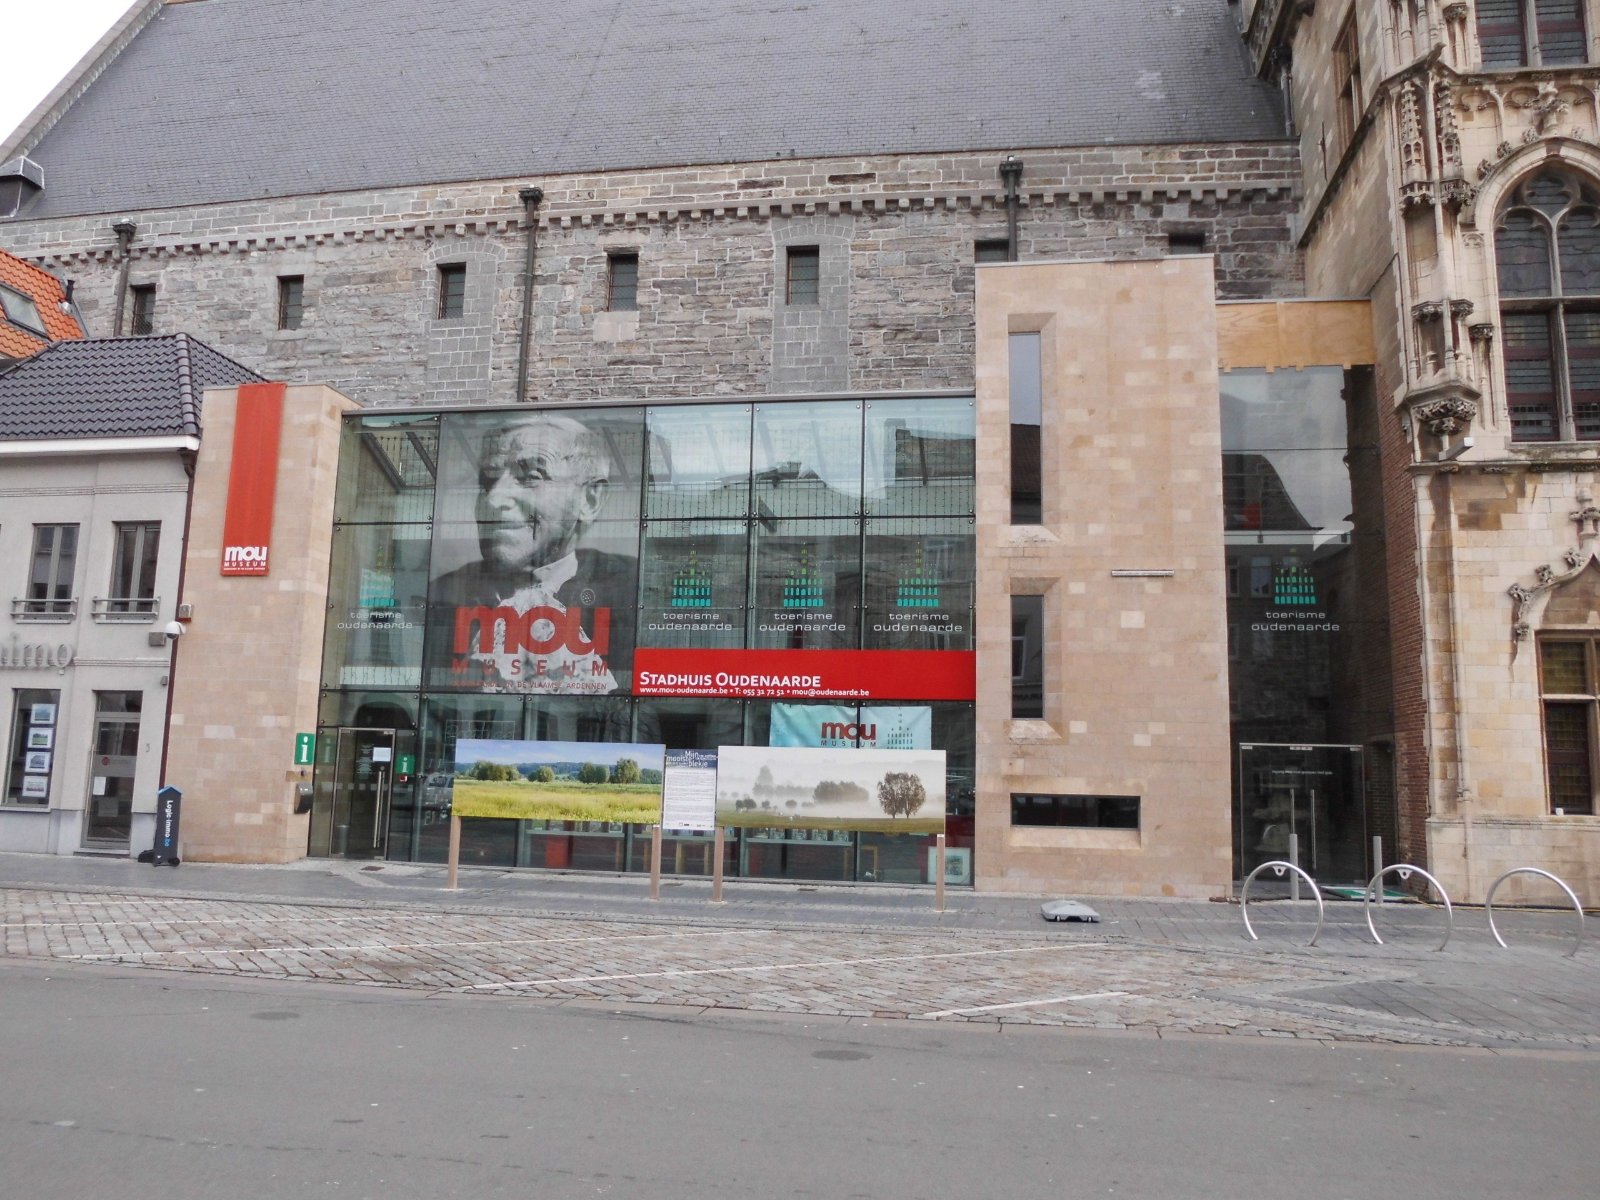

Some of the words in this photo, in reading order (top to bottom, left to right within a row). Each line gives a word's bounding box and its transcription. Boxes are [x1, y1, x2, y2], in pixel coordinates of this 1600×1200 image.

[225, 546, 267, 561] mou
[350, 611, 401, 619] toerisme
[663, 612, 720, 620] toerisme
[774, 612, 833, 620] toerisme
[889, 612, 950, 621] toerisme
[1265, 611, 1326, 619] toerisme
[337, 621, 413, 629] oudenaarde
[648, 622, 733, 631] oudenaarde
[759, 622, 846, 632] oudenaarde
[873, 623, 963, 632] oudenaarde
[1251, 622, 1340, 631] oudenaarde
[453, 605, 610, 655] mou
[451, 659, 607, 676] MUSEUM
[640, 687, 728, 695] www.mou-oudenaarde.be
[743, 688, 755, 696] 055
[792, 688, 870, 697] mou@oudenaarde.be
[821, 722, 877, 741] mou
[820, 739, 877, 748] MUSEUM
